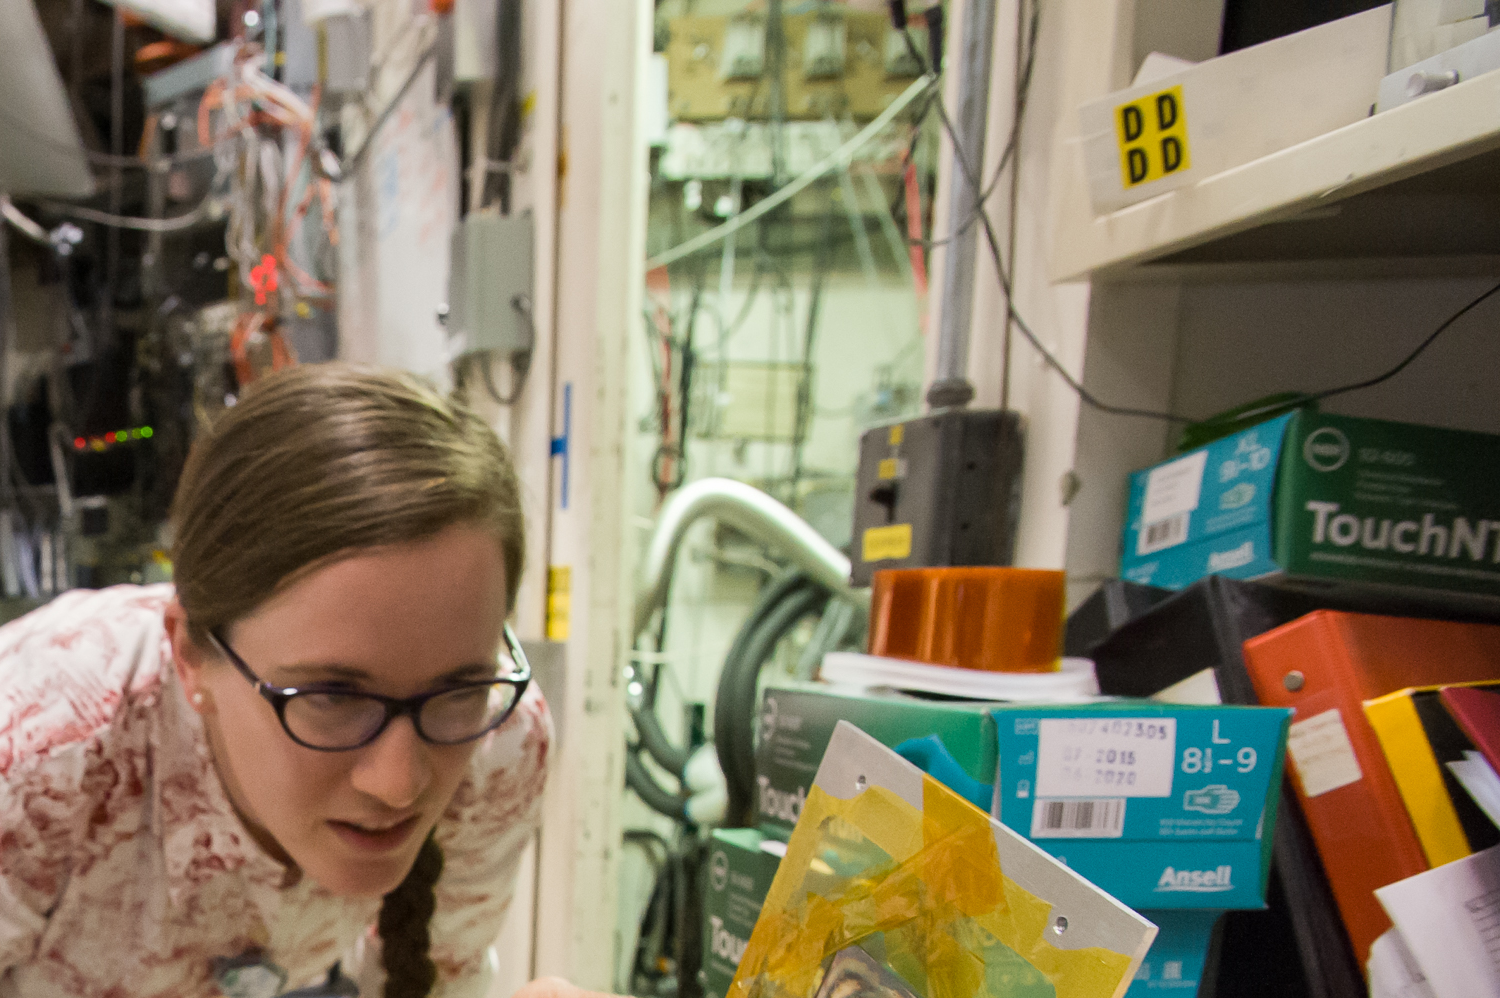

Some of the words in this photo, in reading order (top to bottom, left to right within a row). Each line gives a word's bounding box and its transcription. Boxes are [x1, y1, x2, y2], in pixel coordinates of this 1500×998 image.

[1122, 105, 1143, 142] D
[1156, 93, 1177, 131] D
[1127, 147, 1148, 184] D
[1161, 135, 1182, 172] D
[1212, 719, 1231, 744] L
[1157, 865, 1233, 889] Ansell
